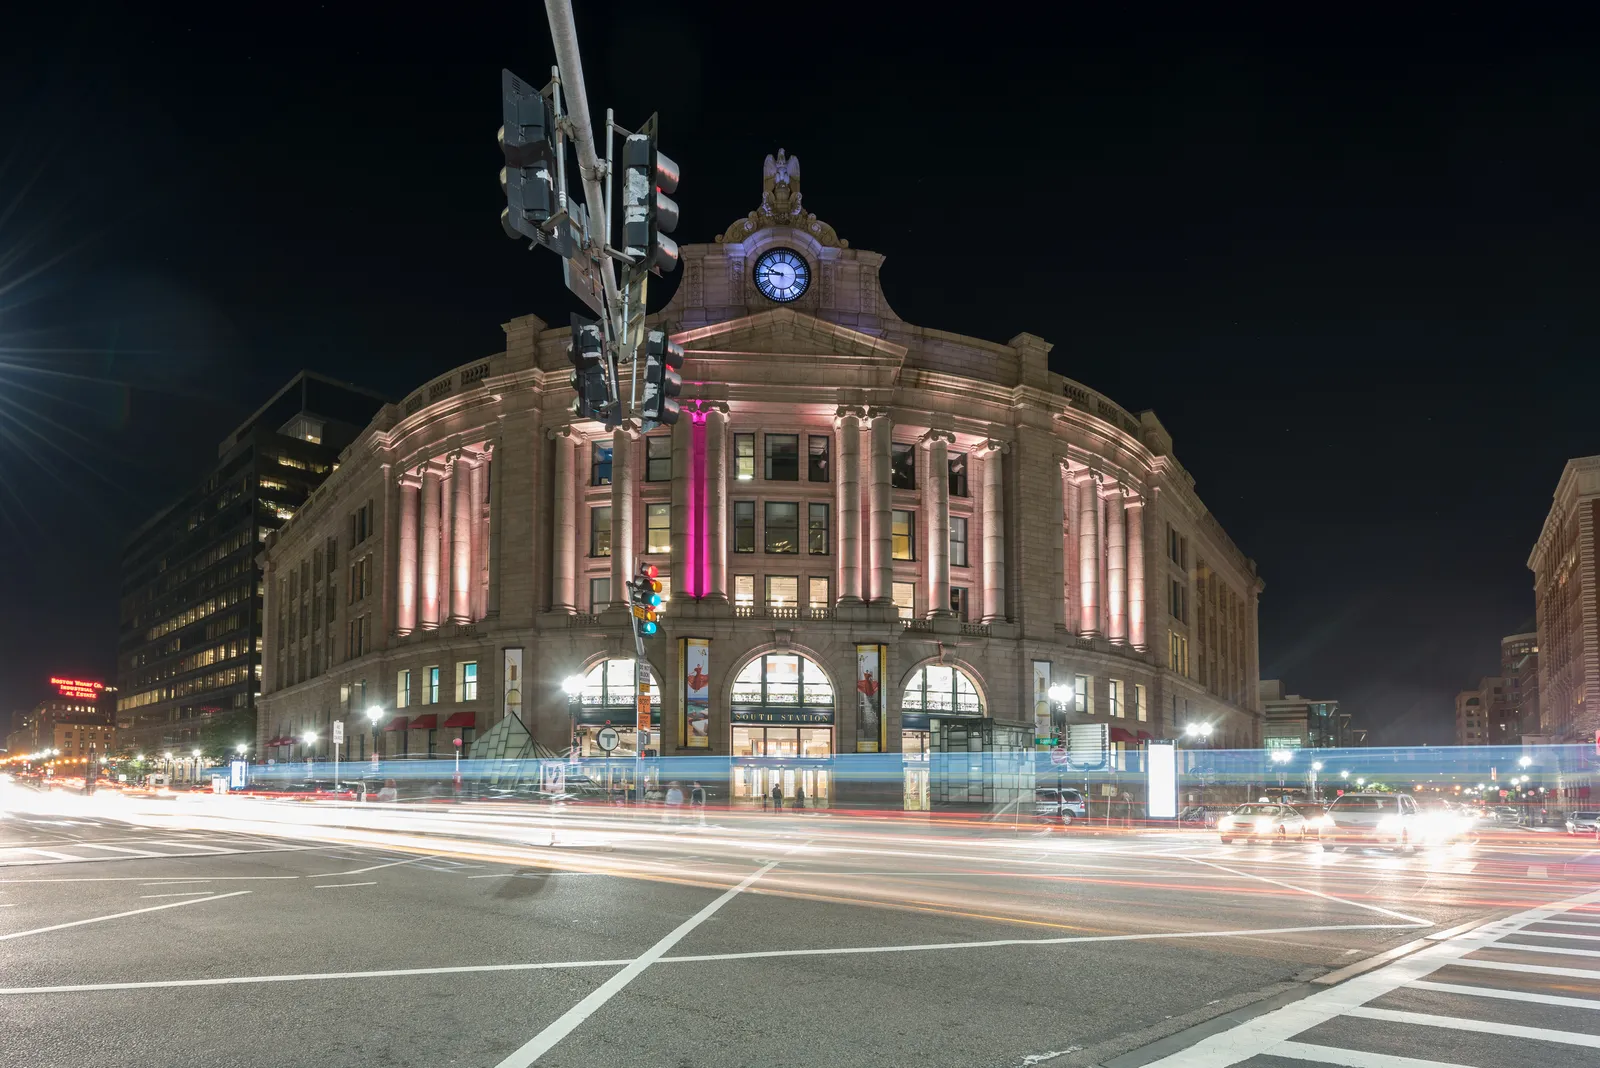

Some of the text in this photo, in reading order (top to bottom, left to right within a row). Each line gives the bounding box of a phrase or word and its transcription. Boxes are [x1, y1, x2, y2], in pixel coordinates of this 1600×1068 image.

[51, 677, 73, 685] BOSTON
[60, 684, 94, 693] INDUSTRIAL
[781, 714, 829, 722] STATION
[601, 733, 616, 748] T
